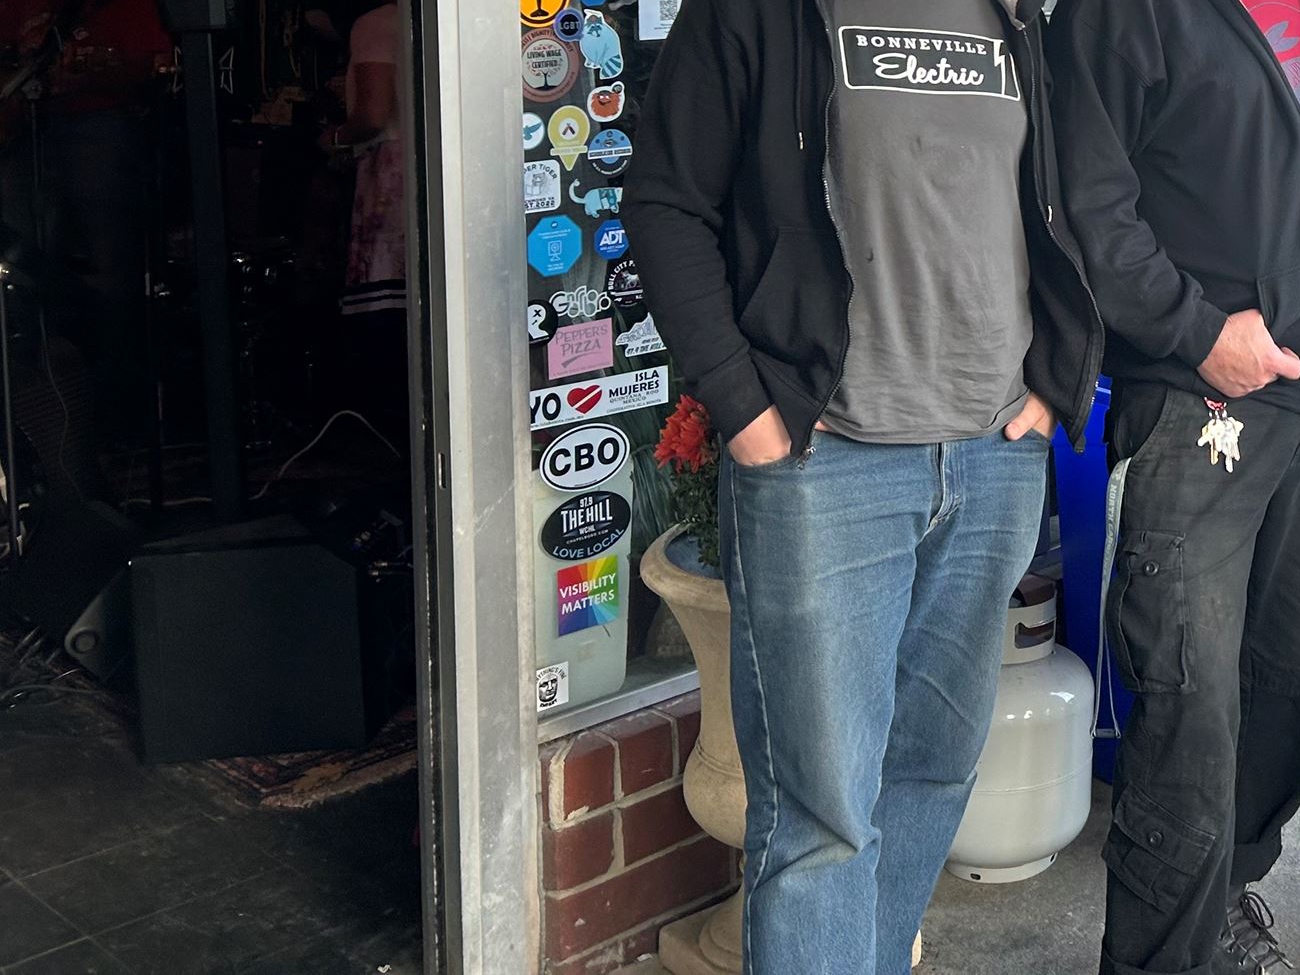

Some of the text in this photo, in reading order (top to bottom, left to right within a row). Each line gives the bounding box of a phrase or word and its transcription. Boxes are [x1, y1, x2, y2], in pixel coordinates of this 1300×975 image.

[527, 48, 562, 59] LIVING WAGE
[856, 34, 987, 55] BONNEVILLE
[532, 60, 558, 69] CERTIFIED
[872, 52, 984, 86] Electric
[600, 230, 625, 246] ADT
[608, 274, 616, 290] BULL
[614, 261, 627, 273] CITY
[561, 339, 600, 356] PIZZA
[635, 370, 659, 383] ISLA
[609, 380, 659, 398] MUJERES
[623, 396, 646, 404] MEXICO
[530, 392, 561, 423] YO
[549, 437, 619, 477] CBO
[580, 496, 593, 508] 97.9
[1107, 484, 1117, 522] NORTH
[561, 498, 613, 533] THE HILL
[552, 528, 624, 558] LOVE LOCAL
[559, 573, 616, 598] VISIBILITY
[561, 590, 615, 615] MATTERS
